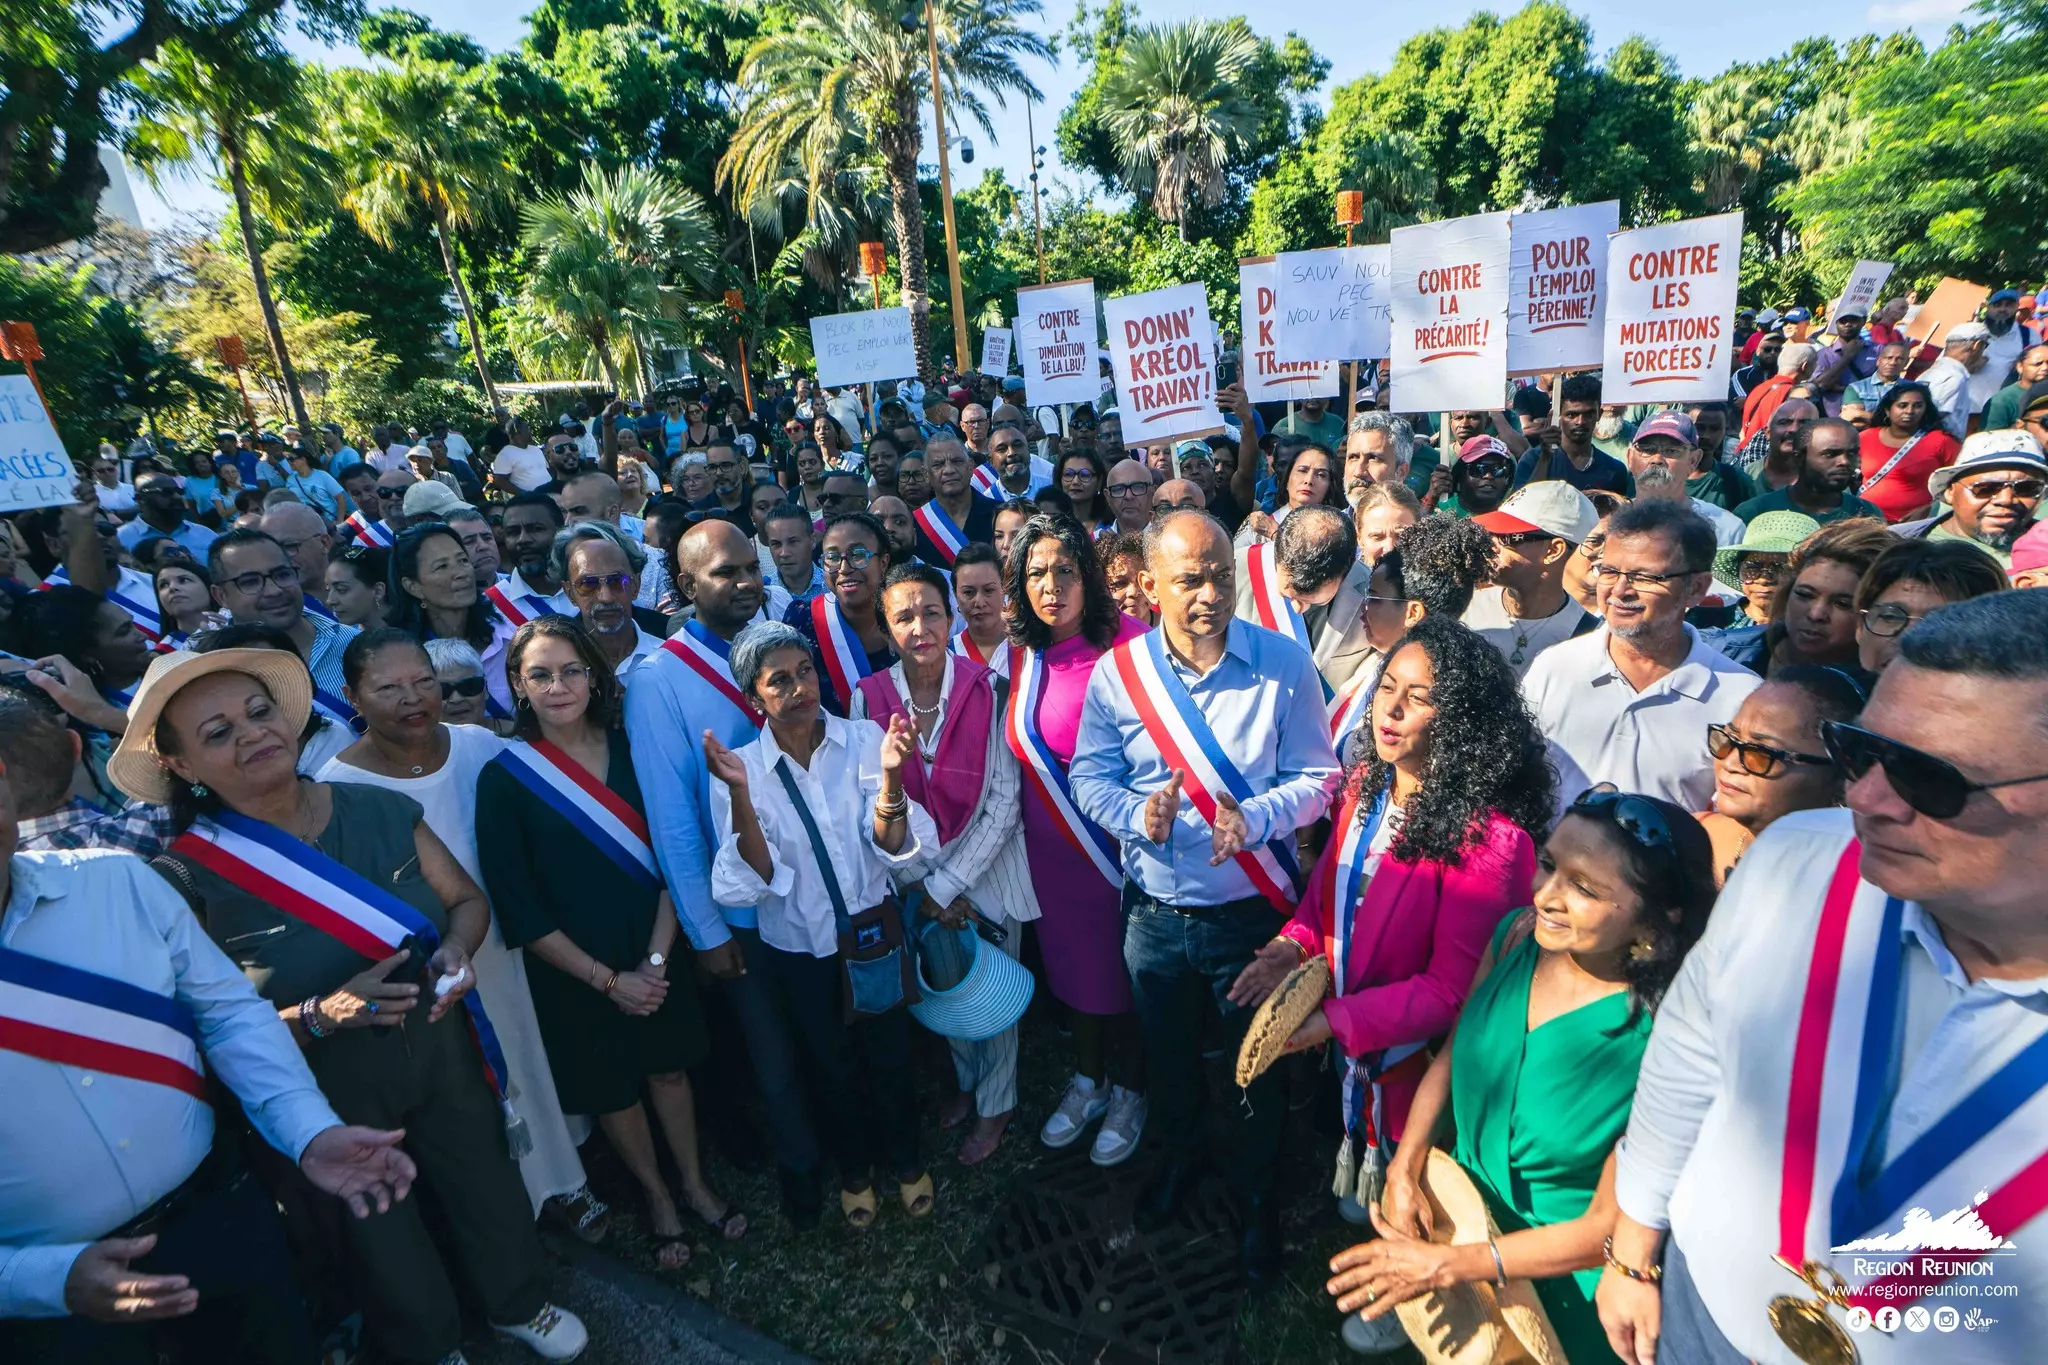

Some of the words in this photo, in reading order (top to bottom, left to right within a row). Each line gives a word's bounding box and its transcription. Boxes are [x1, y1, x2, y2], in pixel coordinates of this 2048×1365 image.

[1532, 236, 1590, 272] POUR
[1629, 243, 1720, 281] CONTRE
[1418, 263, 1481, 295] CONTRE
[1528, 268, 1596, 298] L'EMPLOI
[1338, 282, 1375, 301] PEC
[1652, 281, 1690, 309] LES
[1286, 307, 1319, 326] NOU
[1439, 294, 1459, 315] LA
[1038, 309, 1081, 330] CONTRE
[1124, 306, 1195, 350] DONN'
[1620, 315, 1720, 345] MUTATIONS
[1054, 329, 1068, 343] LA
[827, 343, 850, 357] PEC
[1038, 342, 1086, 360] DIMINUTION
[1129, 342, 1207, 382] KRÉOL
[1041, 360, 1051, 374] DE
[1053, 359, 1063, 373] LA
